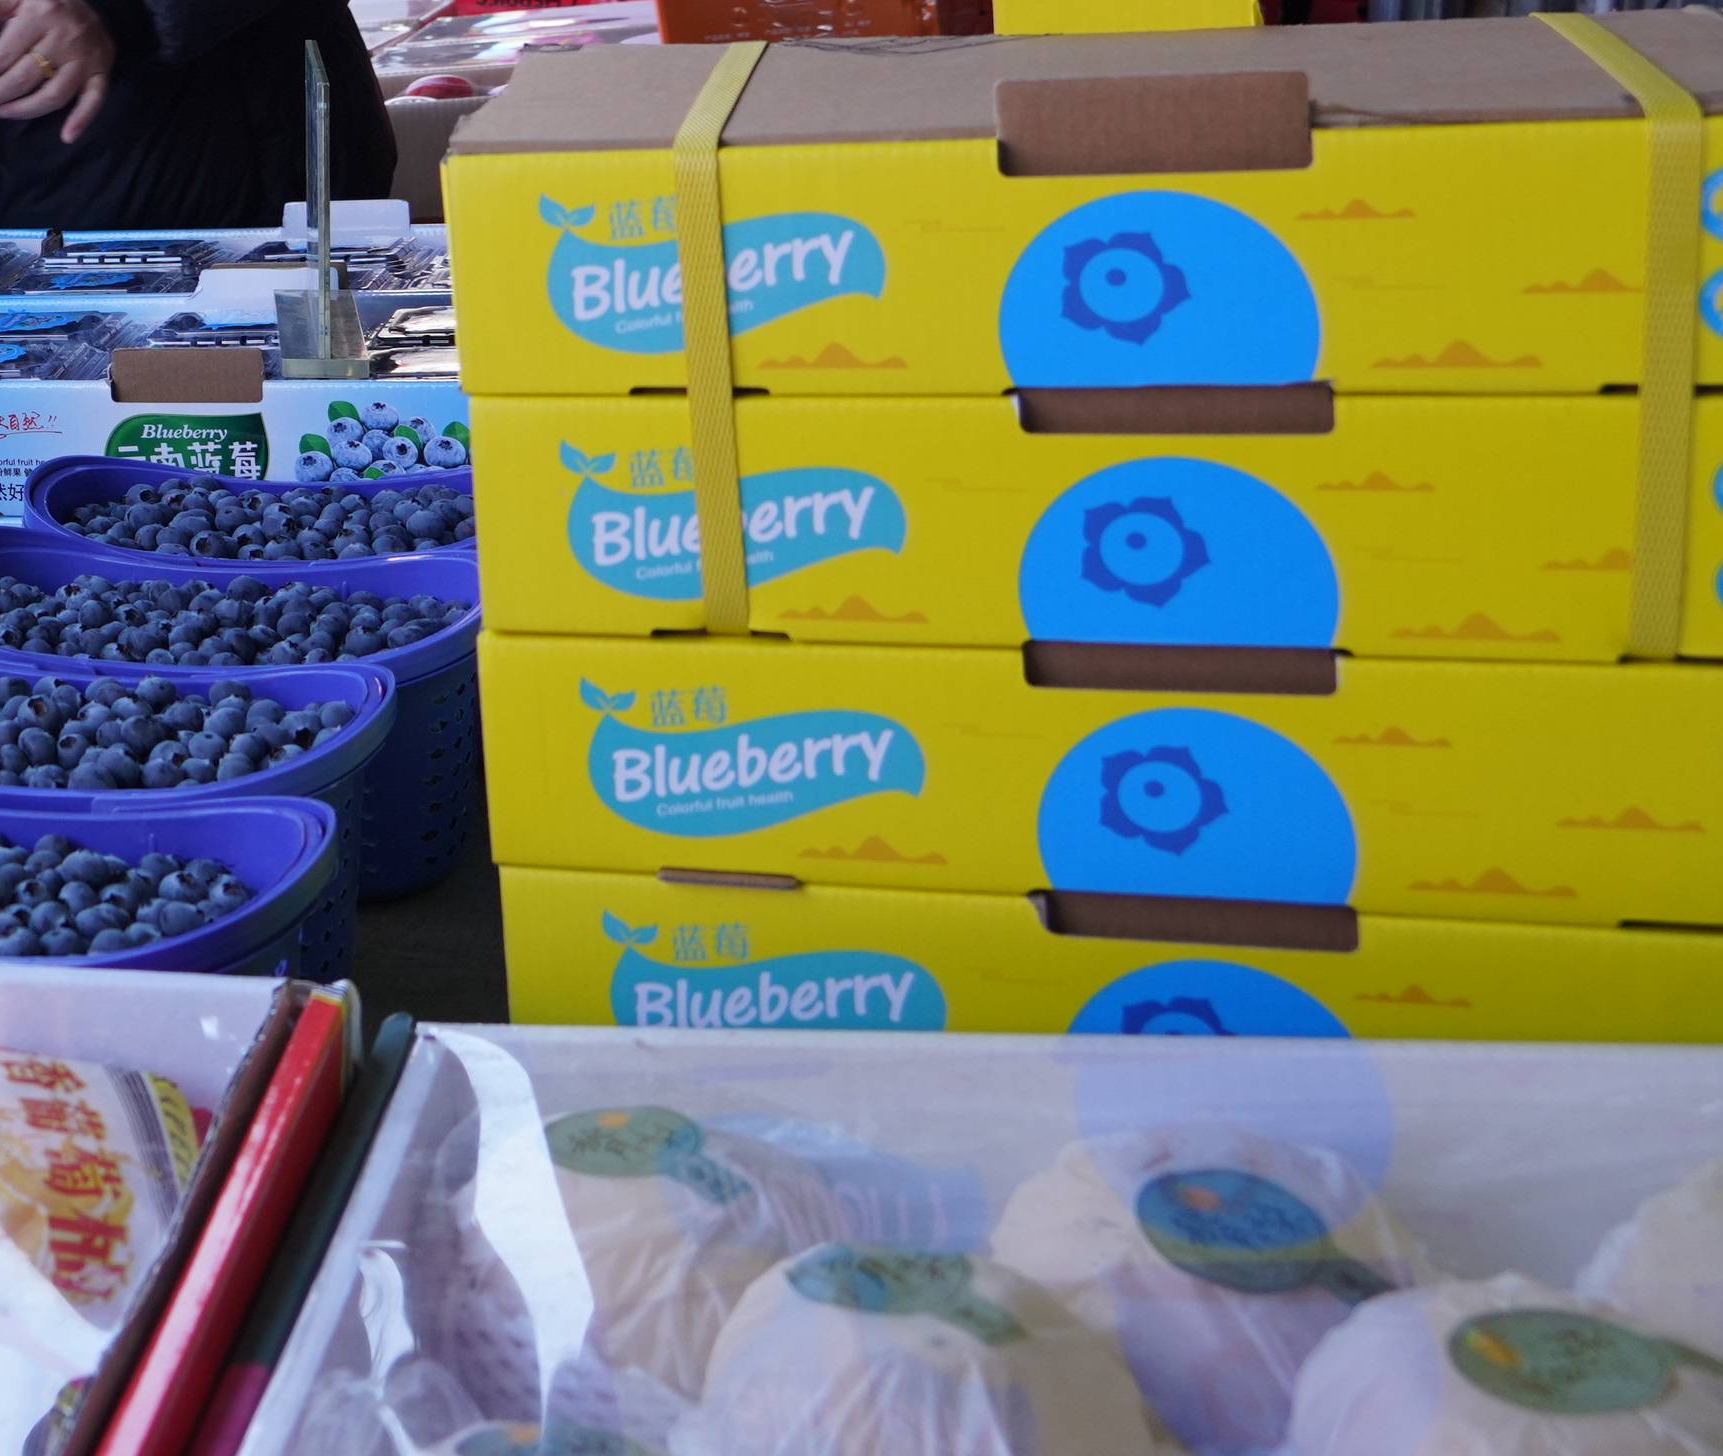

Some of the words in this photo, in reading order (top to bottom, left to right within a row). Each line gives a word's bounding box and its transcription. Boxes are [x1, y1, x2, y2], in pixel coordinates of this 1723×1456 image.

[571, 230, 855, 322] Blueerry
[614, 310, 672, 335] Colorful
[140, 423, 229, 442] Blueberry
[17, 457, 34, 466] fruit
[591, 486, 876, 568] Blueerry
[635, 561, 694, 581] Colorful
[650, 683, 731, 727] 蓝莓
[611, 728, 895, 804] Blueberry
[656, 796, 714, 818] Colorful
[715, 795, 746, 811] fruit
[748, 790, 795, 807] health
[672, 923, 751, 961] 蓝莓
[633, 970, 916, 1029] Blueberry
